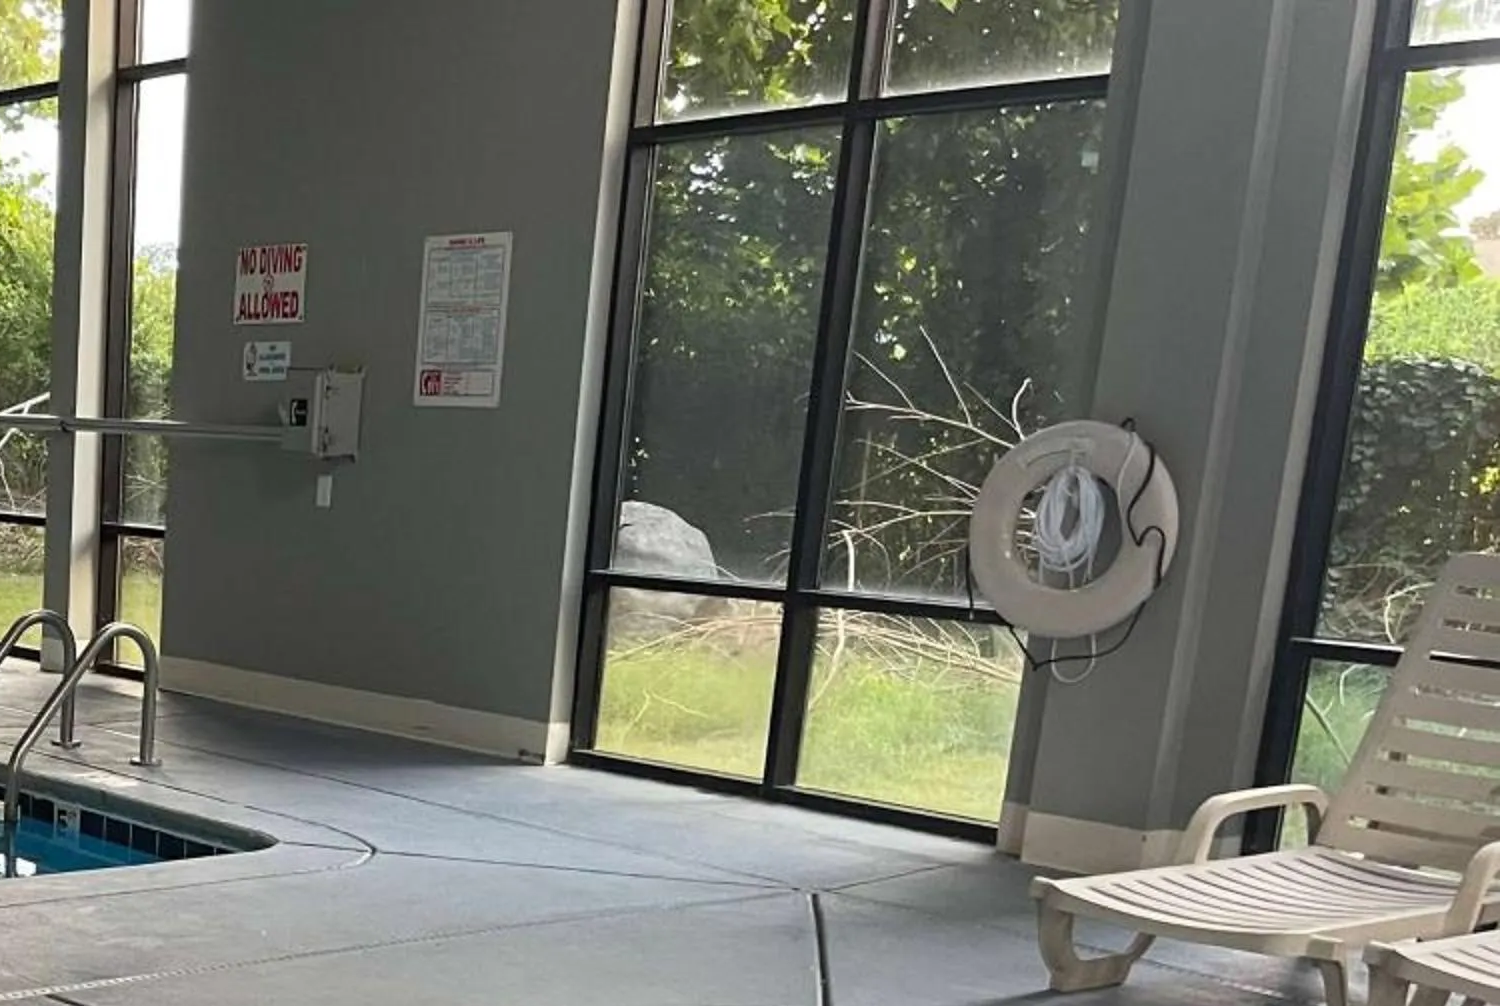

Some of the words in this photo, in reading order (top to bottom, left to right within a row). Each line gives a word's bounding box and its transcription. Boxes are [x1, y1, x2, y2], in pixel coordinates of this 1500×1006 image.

[241, 248, 257, 275] NO
[260, 246, 303, 274] DIVING
[239, 291, 299, 320] ALLOWED
